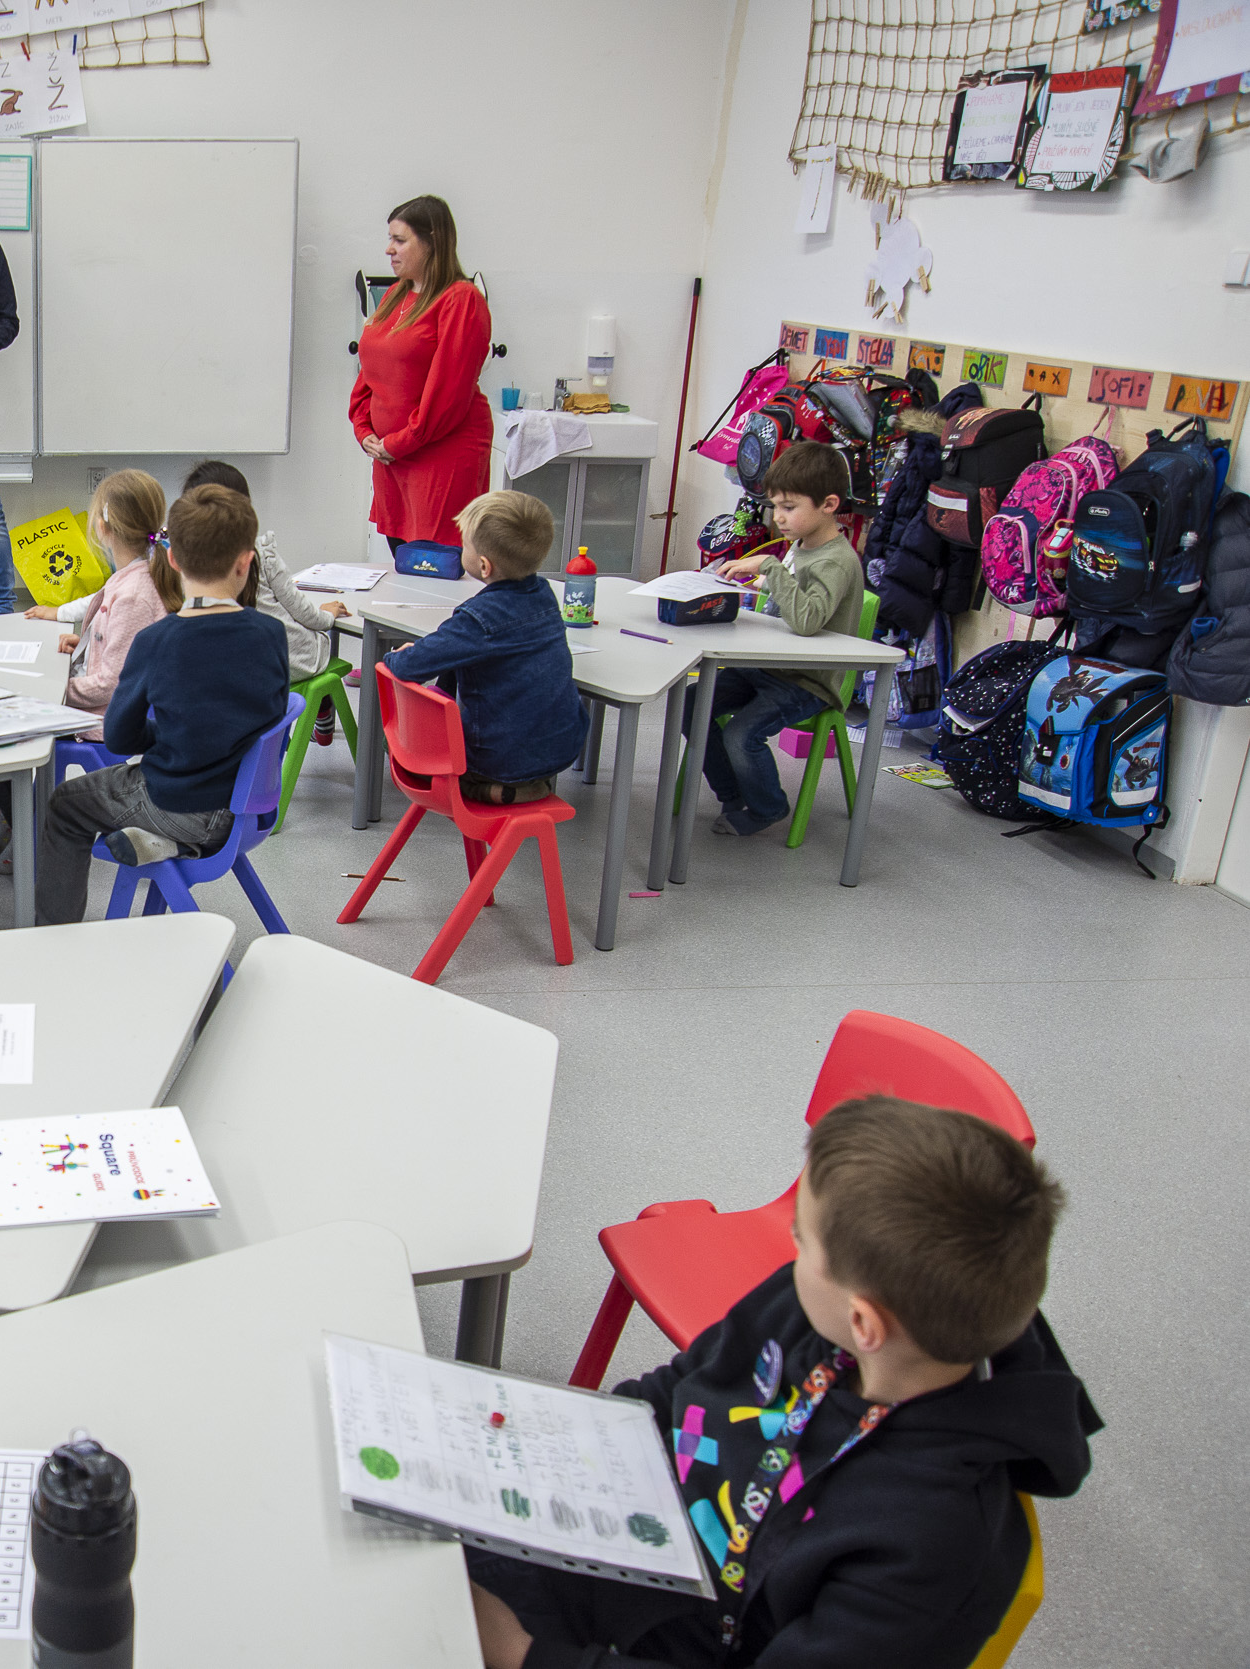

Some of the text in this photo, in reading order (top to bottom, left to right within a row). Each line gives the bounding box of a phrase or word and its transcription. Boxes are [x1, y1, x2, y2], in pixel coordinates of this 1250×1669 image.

[0, 62, 11, 78] Z
[17, 521, 68, 549] PLASTIC
[41, 543, 65, 559] RECYCLE
[72, 555, 82, 576] REDUCE
[700, 596, 724, 611] FAST
[99, 1133, 121, 1176] Square
[93, 1173, 106, 1191] GUIDE
